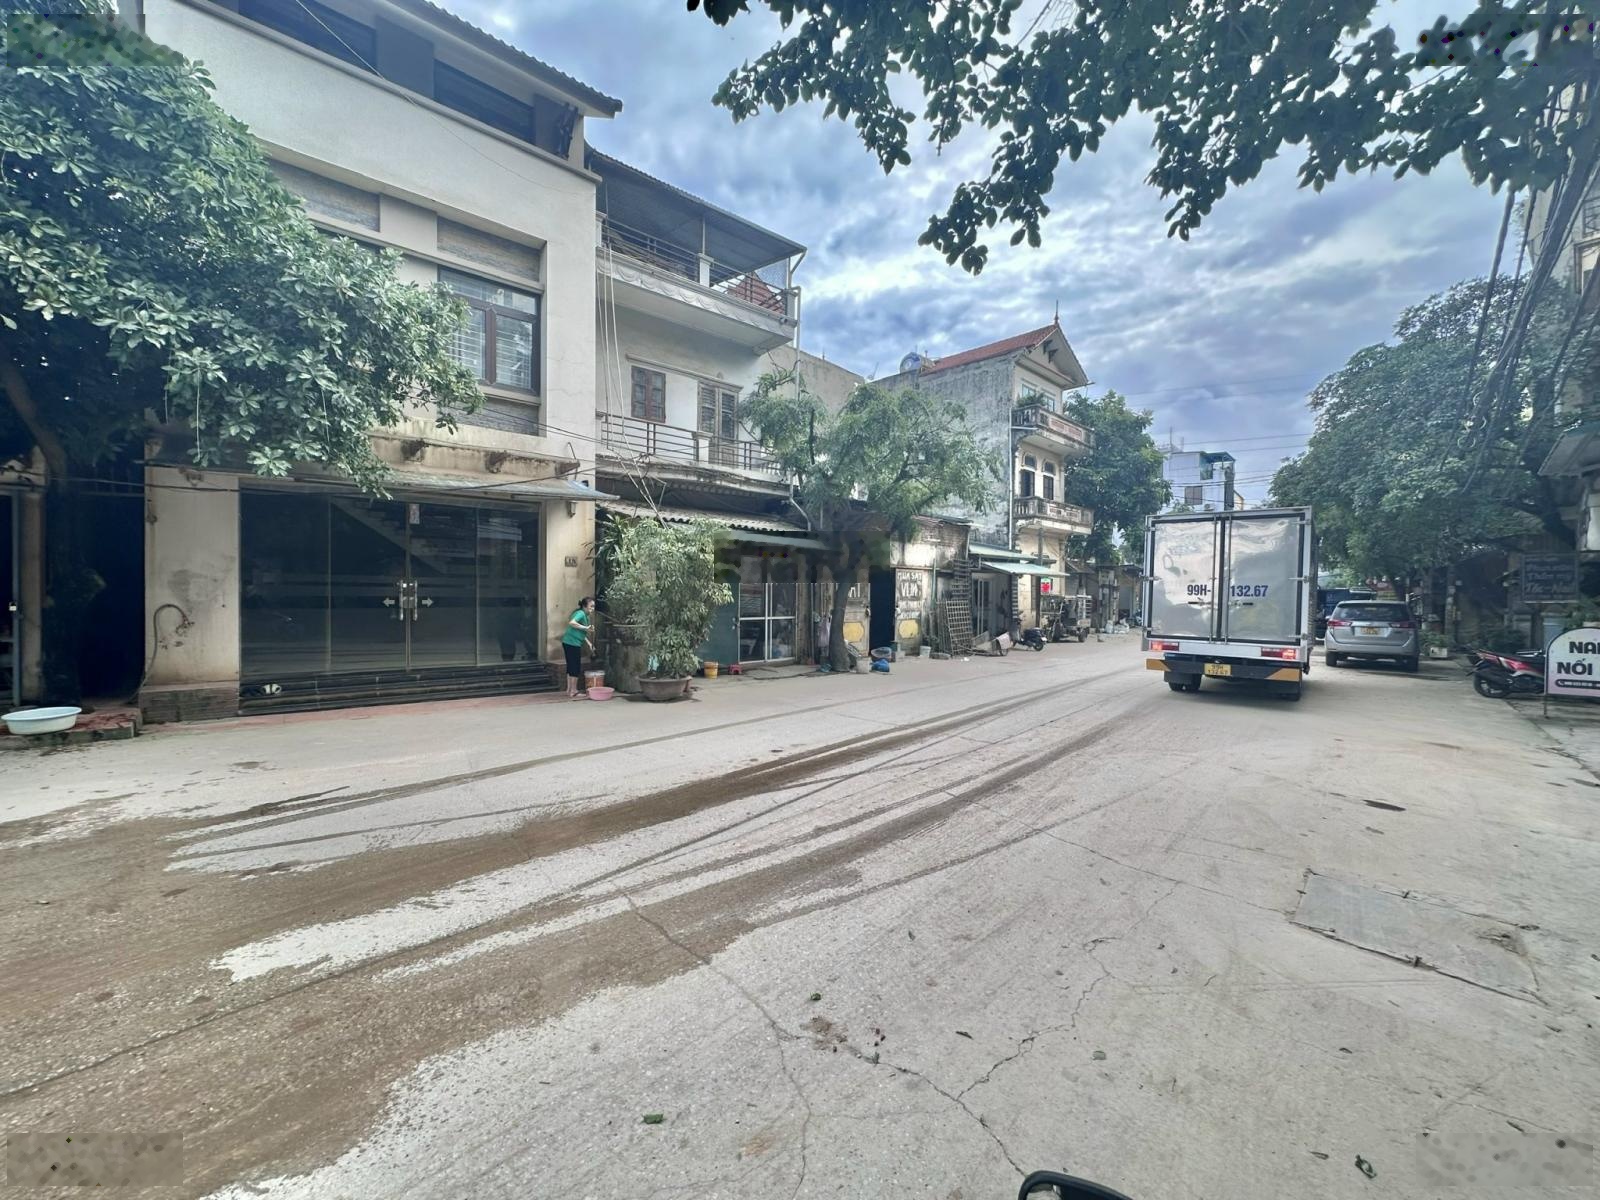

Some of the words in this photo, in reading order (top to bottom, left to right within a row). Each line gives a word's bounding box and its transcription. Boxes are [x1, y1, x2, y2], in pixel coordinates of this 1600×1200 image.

[1187, 584, 1211, 596] 99H-
[1230, 585, 1268, 597] 132.67
[1557, 658, 1592, 676] NỐI
